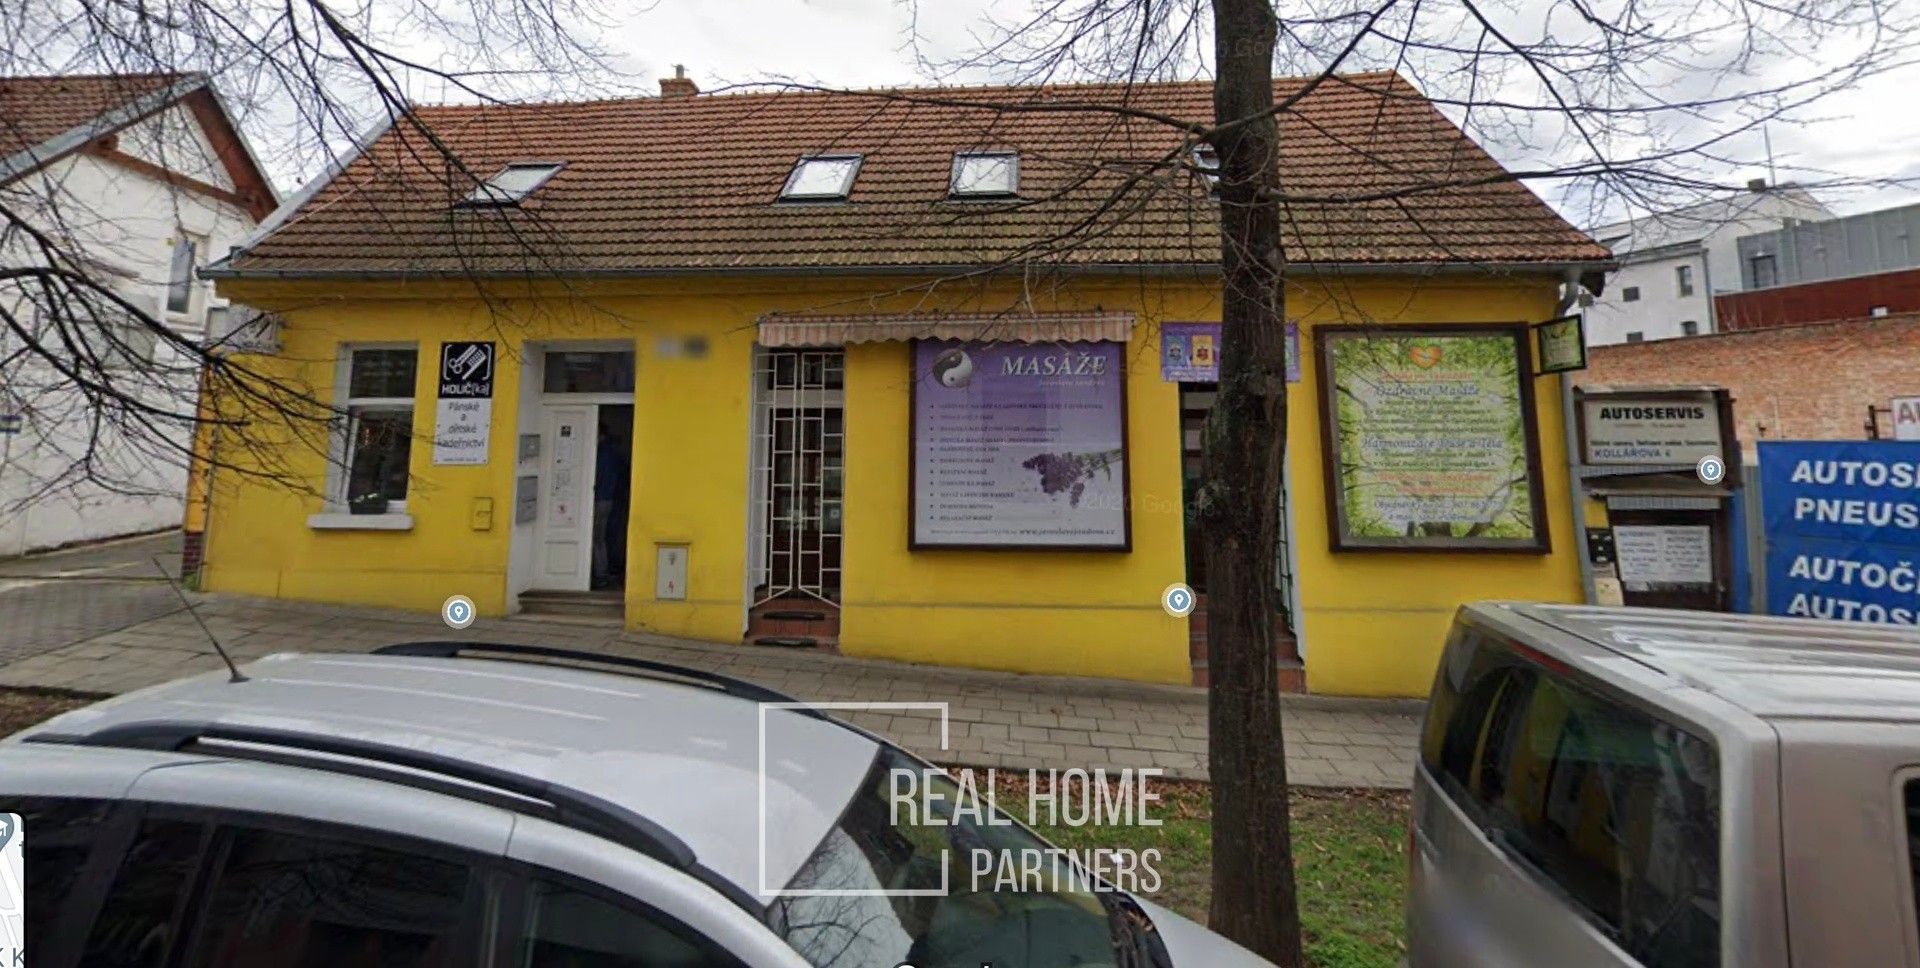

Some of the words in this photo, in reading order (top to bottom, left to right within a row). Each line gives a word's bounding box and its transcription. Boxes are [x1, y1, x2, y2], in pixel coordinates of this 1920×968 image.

[1000, 351, 1107, 376] MASÁŽE
[1600, 406, 1705, 420] AUTOSERVIS
[1788, 593, 1920, 626] AUTOS
